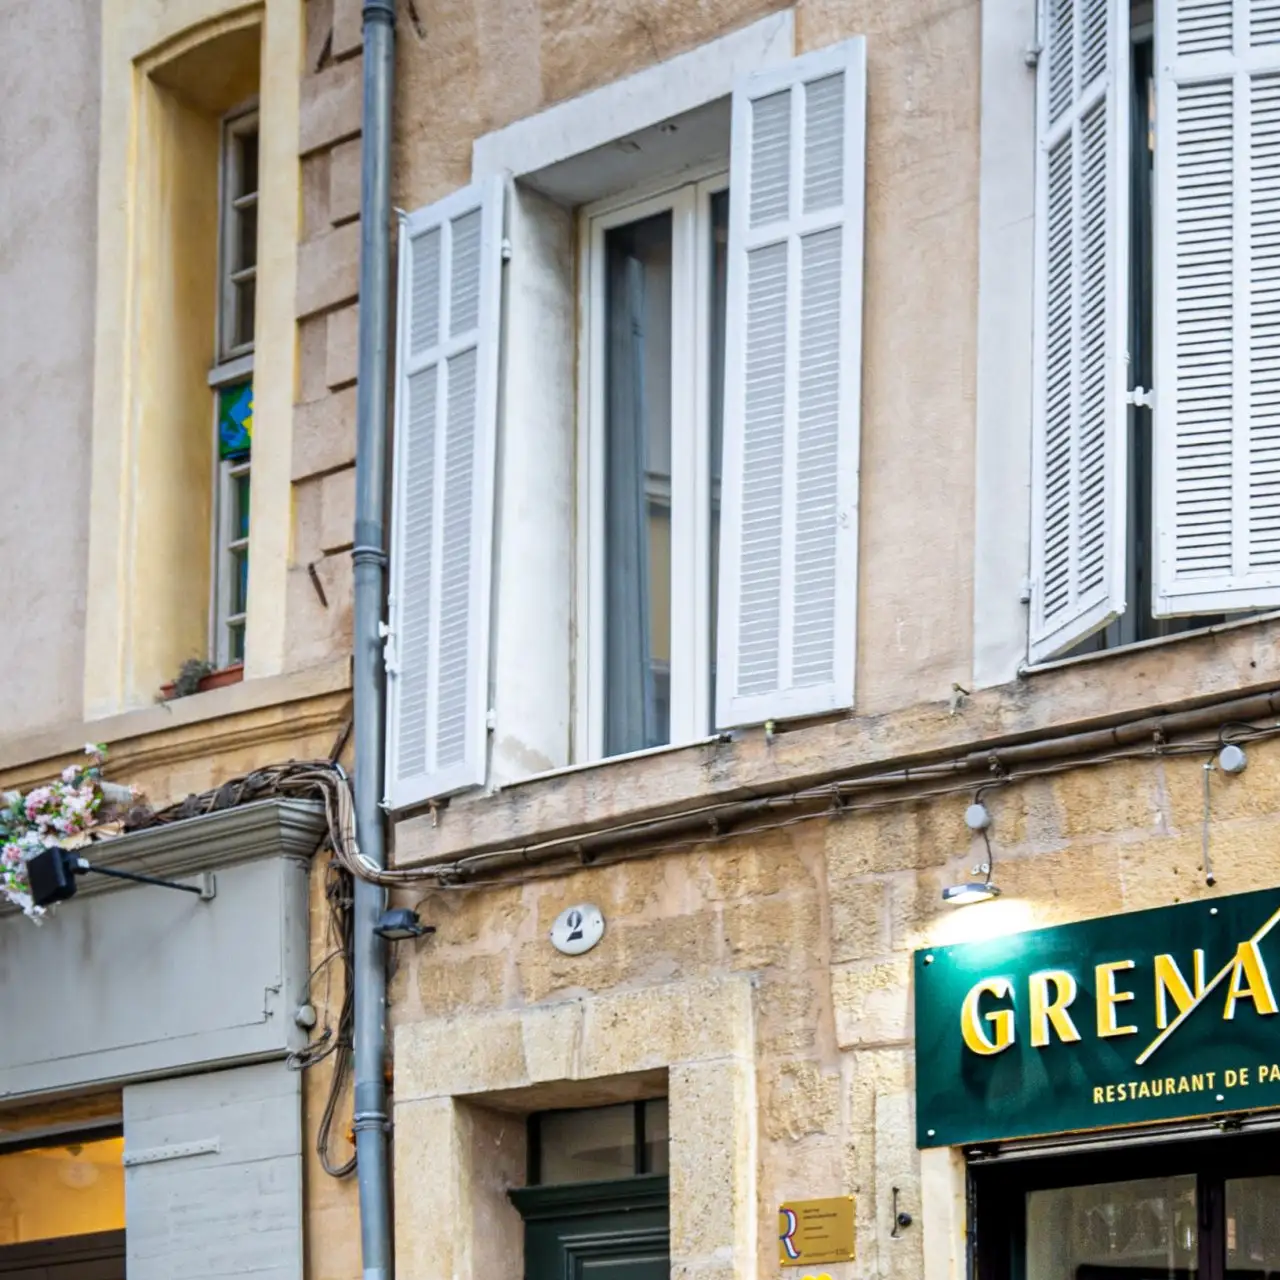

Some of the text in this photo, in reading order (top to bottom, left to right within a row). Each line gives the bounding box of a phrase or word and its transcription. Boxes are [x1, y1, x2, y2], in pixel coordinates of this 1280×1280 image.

[566, 909, 584, 942] 2
[1092, 1071, 1217, 1105] RESTAURANT
[1224, 1068, 1250, 1087] DE
